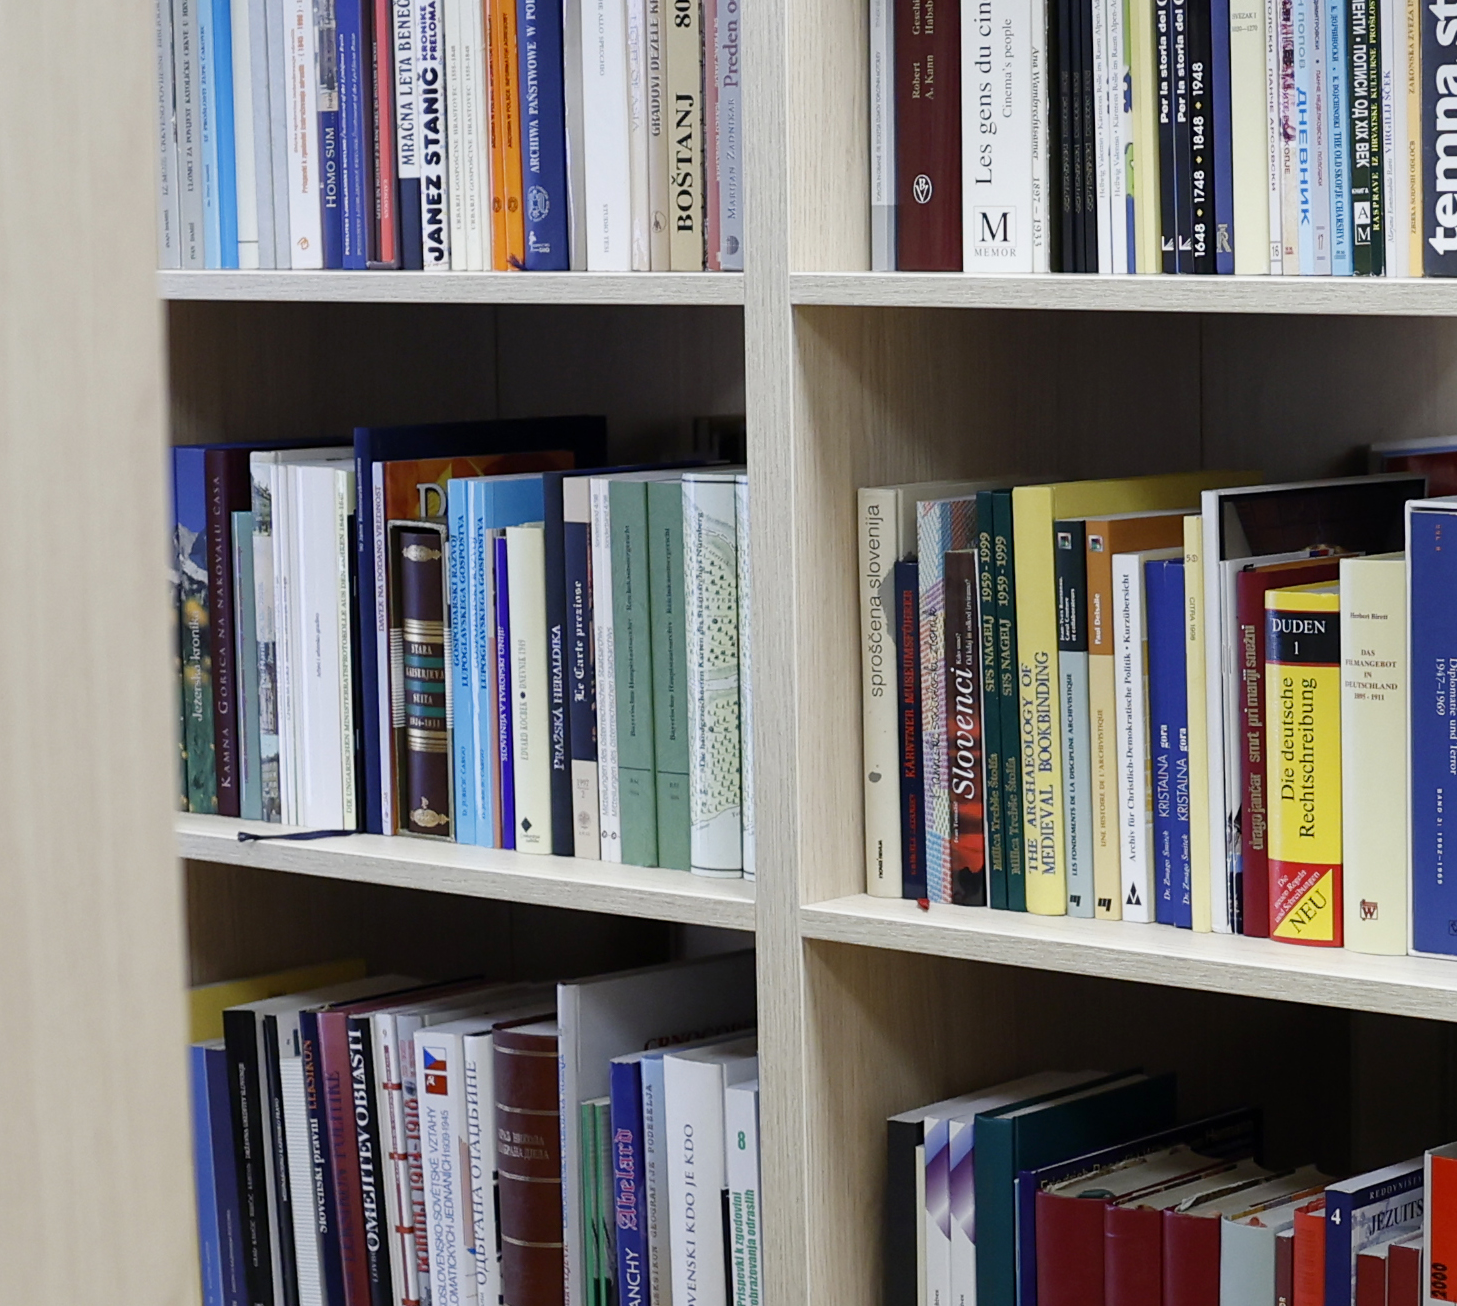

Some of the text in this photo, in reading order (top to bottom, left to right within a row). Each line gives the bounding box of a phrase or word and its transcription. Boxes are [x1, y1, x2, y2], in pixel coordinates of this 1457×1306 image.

[420, 5, 428, 61] KRONIKE
[429, 1, 437, 61] PRELOMA
[398, 56, 414, 96] LETA
[912, 62, 921, 99] Robert
[925, 55, 934, 100] A. Kann
[975, 45, 991, 74] du
[979, 82, 996, 135] gens
[396, 102, 415, 165] MRAČNA
[324, 127, 337, 208] HOMO SUM
[417, 67, 444, 261] JANEZ STANIČ
[671, 93, 694, 233] BOŠTANJ
[975, 144, 992, 185] Les
[1192, 62, 1205, 257] 1648 1748 1848 1948
[979, 211, 1010, 242] M
[376, 538, 384, 581] DODANO
[377, 584, 383, 597] NA
[864, 504, 886, 697] sproščena slovenija
[1122, 574, 1131, 643] Kurzübersicht
[1093, 593, 1102, 644] Paul Delsalle
[1272, 618, 1326, 634] DUDEN
[189, 611, 203, 721] Jezerska kronika
[214, 524, 231, 788] KAMNA GORICA NA NAKOVALU
[1123, 653, 1133, 684] Politik
[1293, 641, 1300, 655] 1
[1345, 658, 1397, 669] FILMANGEBOT
[1361, 649, 1375, 657] DAS
[951, 667, 975, 799] Slovenci
[1124, 686, 1135, 809] Christlich-Demokratische
[1280, 677, 1295, 800] Die deutsche
[1035, 651, 1055, 874] MEDIEVAL BOOKBINDING
[1298, 678, 1317, 838] Rechtschreibung
[1128, 828, 1137, 861] Archiv
[1289, 888, 1328, 934] NEU
[426, 1107, 438, 1153] VZTAHY
[683, 1124, 694, 1165] KDO
[685, 1169, 695, 1187] JE
[685, 1193, 696, 1234] KDO
[732, 1191, 745, 1247] zgodovini
[1330, 1208, 1341, 1224] 4
